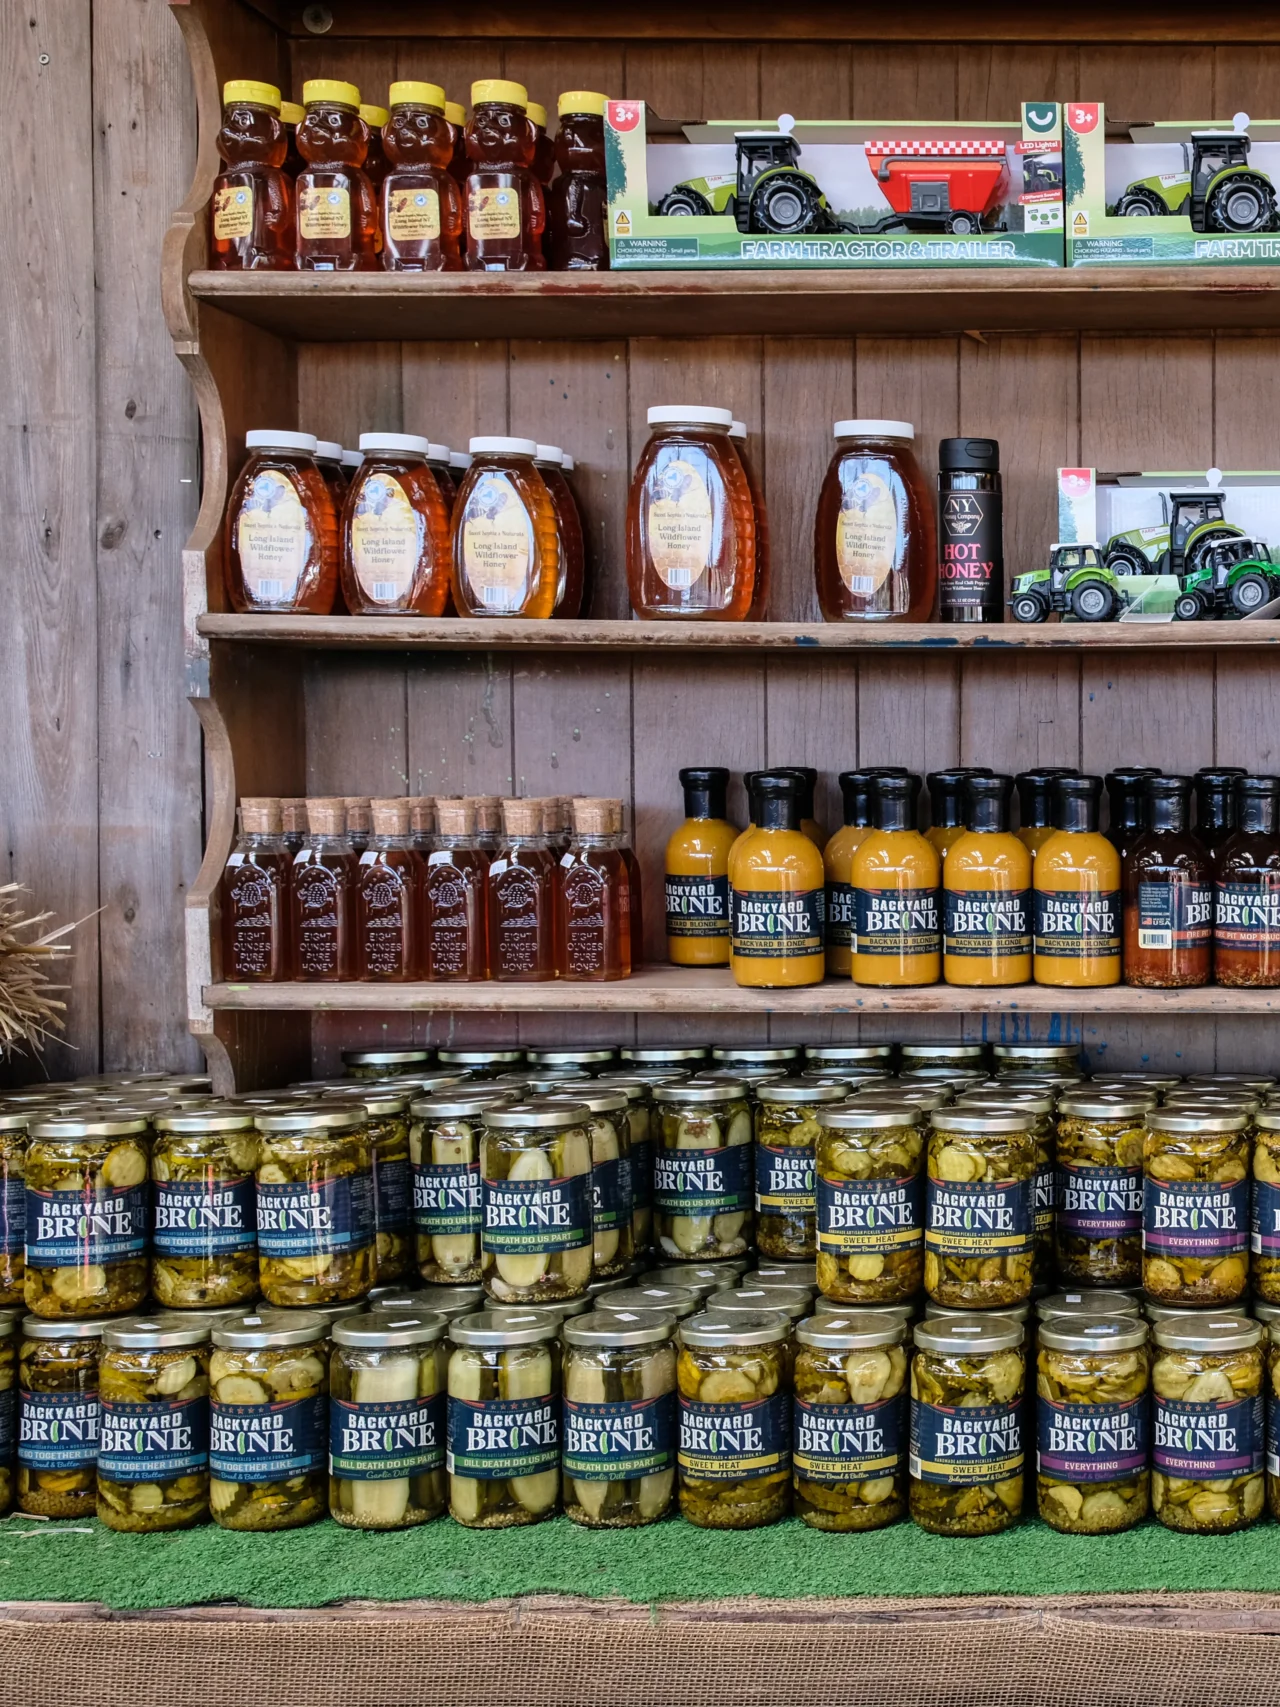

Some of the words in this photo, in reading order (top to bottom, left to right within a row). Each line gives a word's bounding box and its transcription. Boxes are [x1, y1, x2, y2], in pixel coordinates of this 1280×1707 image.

[615, 109, 634, 122] 3+
[1075, 110, 1093, 124] 3+
[1035, 141, 1058, 150] Lights!
[742, 241, 804, 259] FARM
[807, 241, 907, 259] TRACTOR
[910, 242, 925, 258] &
[926, 241, 1015, 259] TRAILER
[1195, 238, 1256, 258] FARM
[950, 499, 972, 512] NY
[658, 524, 676, 533] Long
[678, 524, 701, 532] Island
[248, 535, 268, 544] Long
[270, 535, 294, 543] Island
[659, 533, 701, 541] Wildflower
[250, 544, 294, 552] Wildflower
[473, 542, 491, 551] Long
[493, 542, 517, 550] Island
[668, 542, 691, 550] Honey
[945, 544, 981, 559] HOT
[258, 553, 282, 562] Honey
[475, 552, 518, 560] Wildflower
[483, 560, 507, 569] Honey
[940, 562, 993, 578] HONEY
[1220, 892, 1278, 906] BACKYARD
[741, 901, 803, 913] BACKYARD
[1047, 900, 1109, 913] BACKYARD
[738, 913, 810, 933] BRINE
[1042, 912, 1114, 933] BRINE
[238, 932, 265, 941] EIGHT
[1227, 931, 1236, 939] PIT
[233, 943, 270, 951] OUNCES
[240, 953, 264, 961] PURE
[236, 963, 267, 971] HONEY
[490, 1189, 561, 1205] BACKYARD
[835, 1189, 905, 1205] BACKYARD
[1160, 1193, 1230, 1208] BACKYARD
[43, 1198, 124, 1216] BACKYARD
[486, 1203, 569, 1227] BRINE
[829, 1203, 913, 1228] BRINE
[1154, 1207, 1236, 1230] BRINE
[36, 1212, 131, 1240] BRINE
[843, 1236, 872, 1244] SWEET
[876, 1235, 896, 1243] HEAT
[1169, 1238, 1219, 1246] EVERYTHING
[59, 1245, 110, 1255] TOGETHER
[504, 1245, 526, 1253] Garlic
[105, 1413, 182, 1430] BACKYARD
[349, 1409, 427, 1429] BACKYARD
[683, 1411, 753, 1430] BACKYARD
[1055, 1412, 1128, 1429] BACKYARD
[101, 1427, 191, 1453] BRINE
[342, 1422, 434, 1452] BRINE
[680, 1425, 762, 1453] BRINE
[1049, 1427, 1136, 1453] BRINE
[118, 1462, 166, 1470] TOGETHER
[690, 1461, 716, 1469] SWEET
[719, 1461, 740, 1469] HEAT
[1065, 1461, 1118, 1470] EVERYTHING
